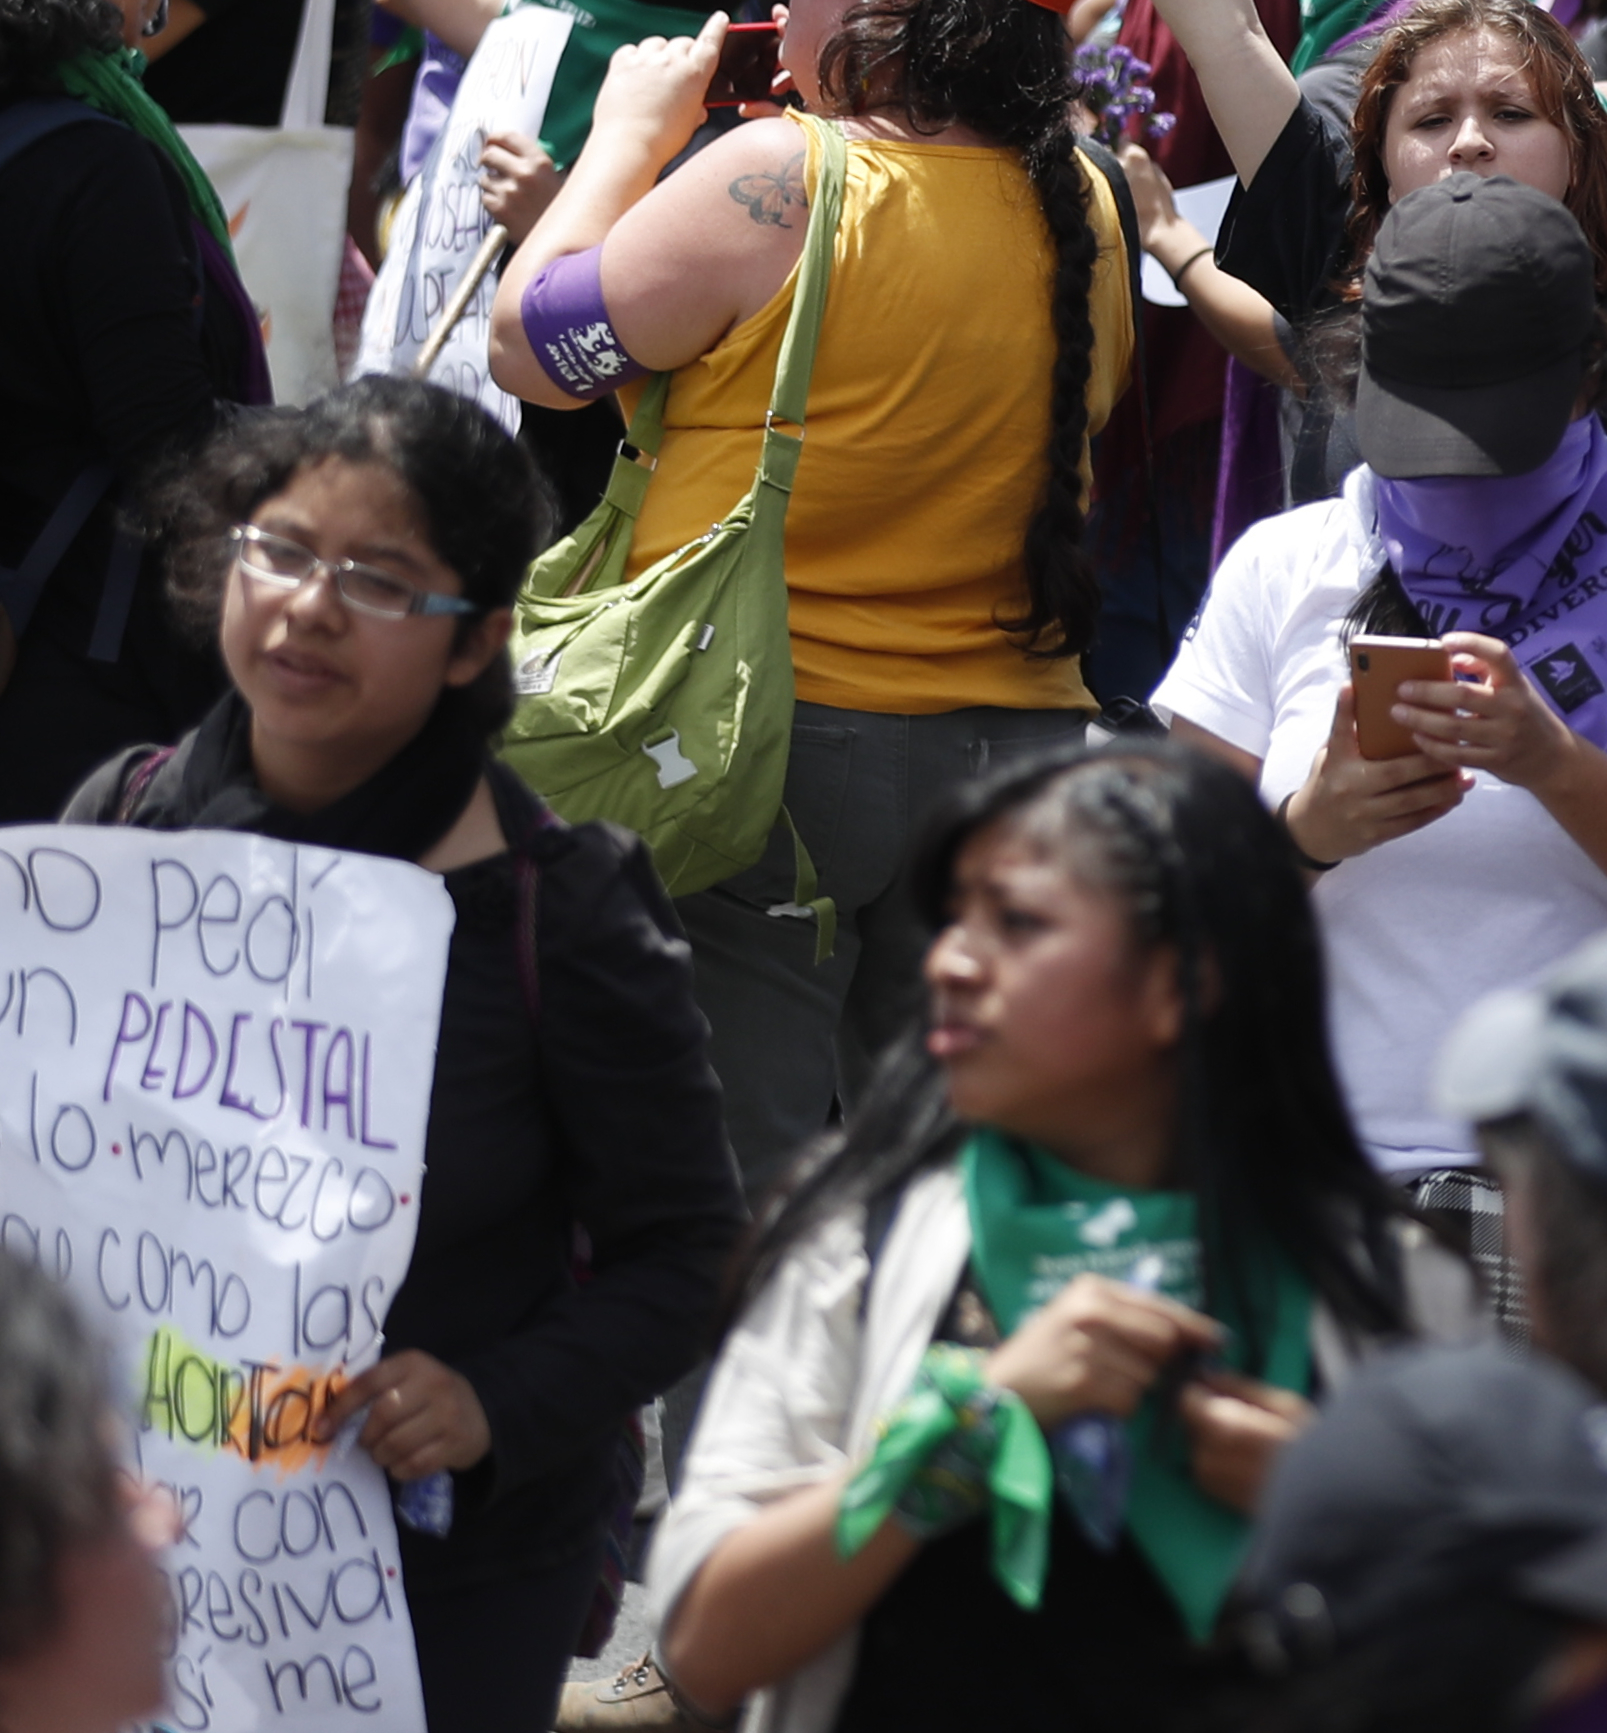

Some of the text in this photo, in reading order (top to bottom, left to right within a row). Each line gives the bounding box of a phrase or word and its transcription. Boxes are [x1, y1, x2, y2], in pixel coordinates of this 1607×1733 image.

[102, 990, 399, 1152] PEDESTAL
[98, 1226, 251, 1339] como
[292, 1259, 385, 1365] las
[233, 1479, 370, 1564] con
[264, 1643, 382, 1715] me
